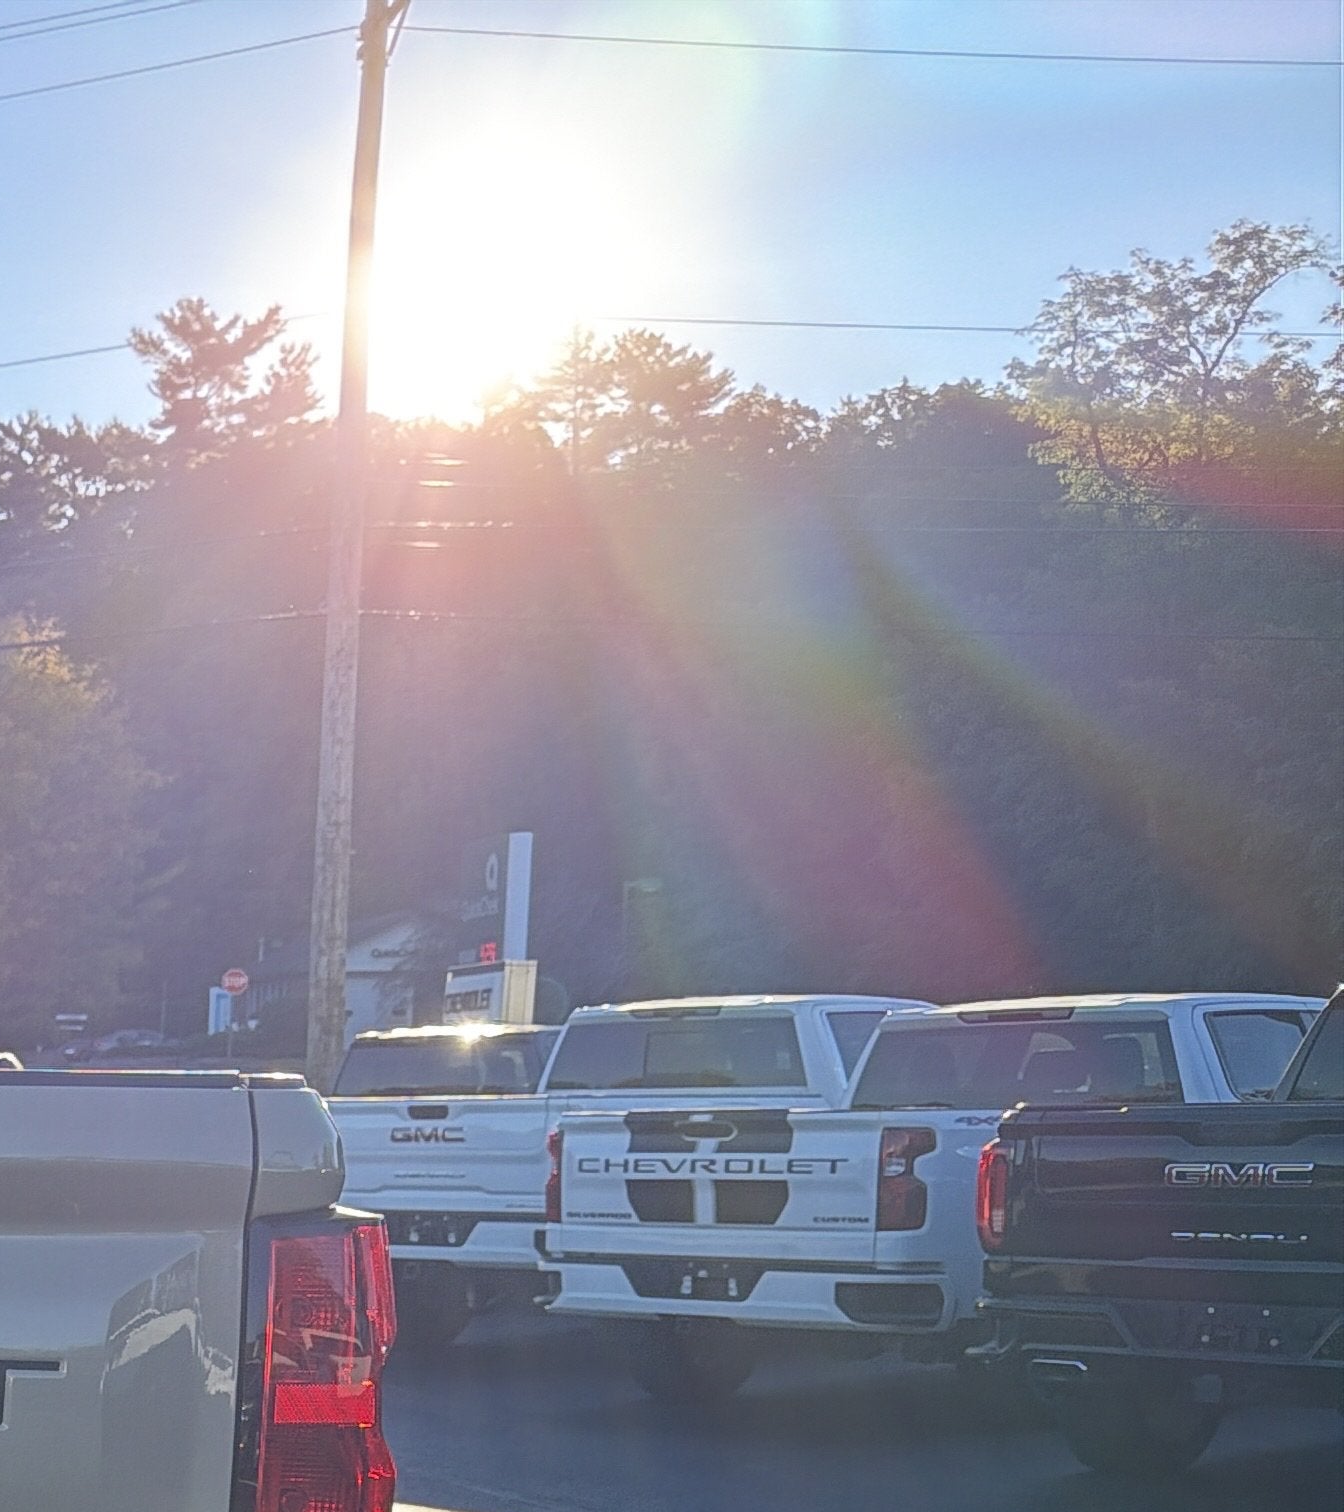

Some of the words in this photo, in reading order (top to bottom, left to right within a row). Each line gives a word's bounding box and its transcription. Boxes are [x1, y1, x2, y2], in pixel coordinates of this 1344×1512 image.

[391, 1126, 466, 1143] GMC
[577, 1157, 849, 1175] CHEVROLET
[1164, 1162, 1315, 1188] GMC
